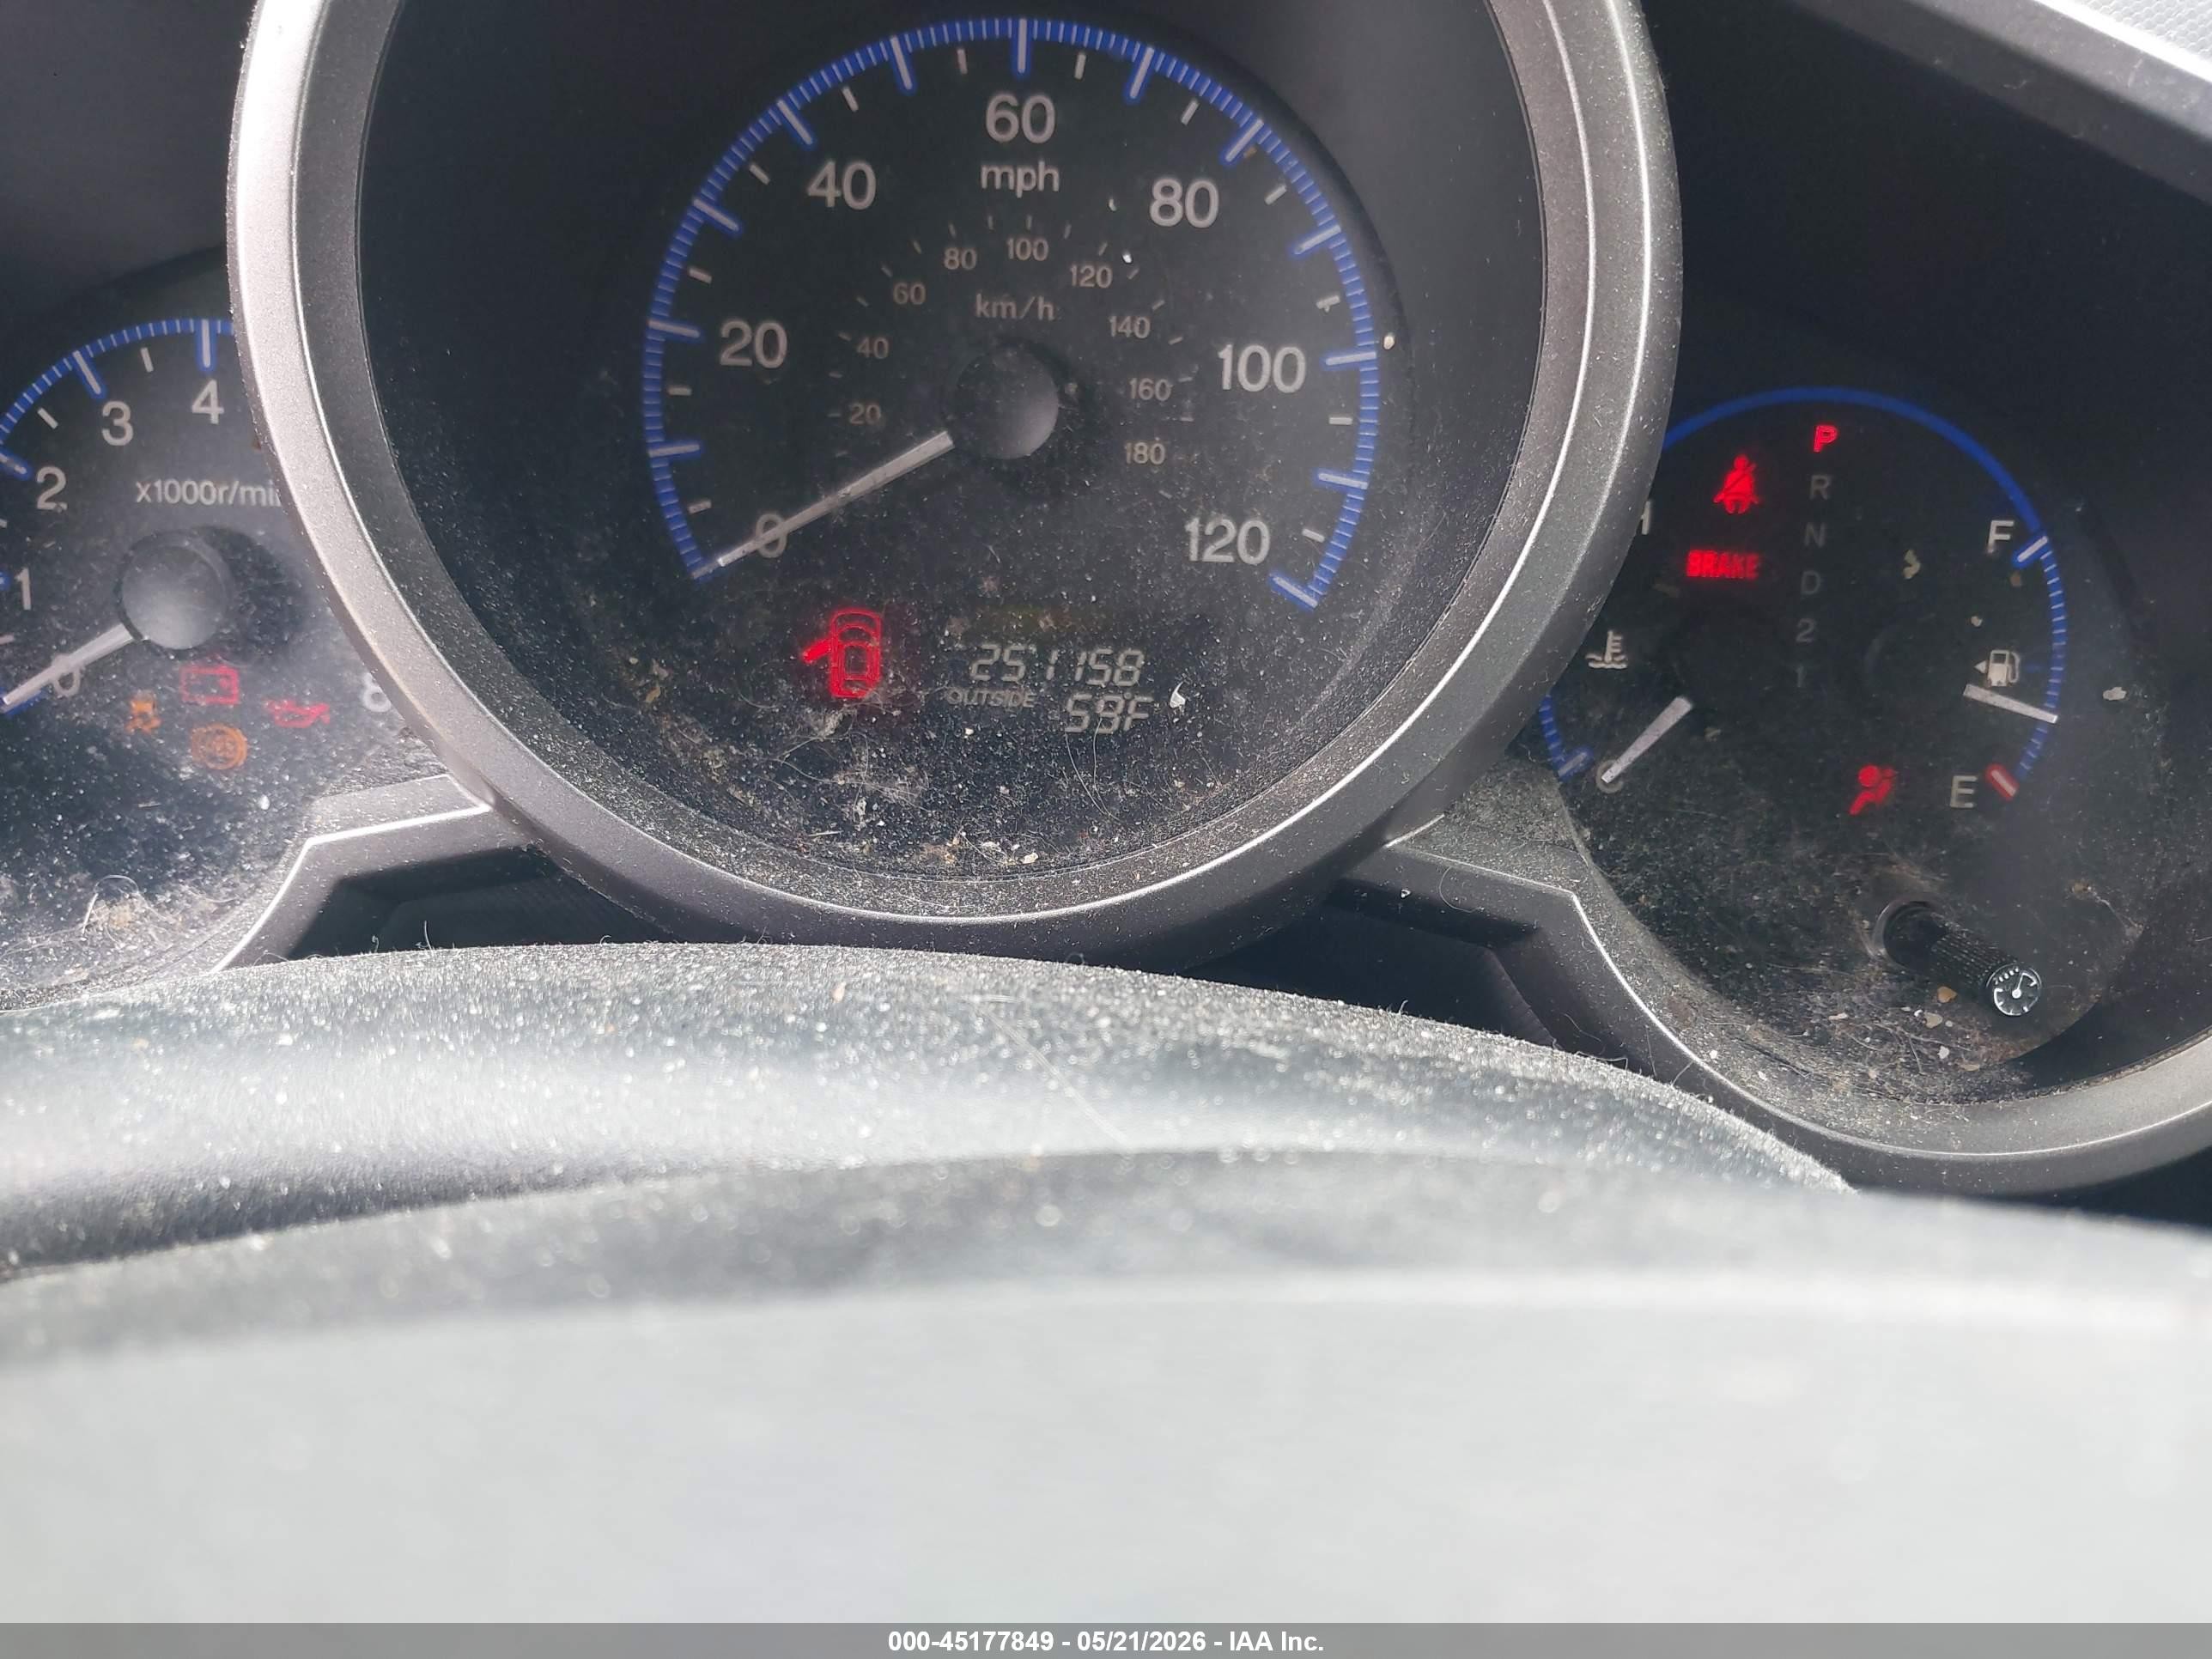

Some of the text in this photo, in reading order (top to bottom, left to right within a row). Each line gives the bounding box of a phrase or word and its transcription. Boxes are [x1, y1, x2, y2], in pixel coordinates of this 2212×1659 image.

[984, 93, 1057, 144] 60
[807, 161, 877, 210] 40
[980, 163, 1060, 198] mph
[1149, 178, 1219, 228] 80
[944, 247, 978, 271] 80
[1006, 237, 1049, 262] 100
[1070, 264, 1113, 289] 120
[893, 282, 927, 306] 60
[975, 294, 1055, 321] km/h
[1109, 315, 1151, 339] 140
[720, 321, 788, 368] 20
[857, 337, 890, 359] 40
[1217, 345, 1307, 393] 100
[191, 380, 224, 424] 4
[1128, 377, 1172, 402] 160
[102, 401, 133, 446] 3
[848, 402, 882, 426] 20
[1813, 424, 1838, 452] P
[1125, 442, 1166, 467] 180
[36, 466, 68, 511] 2
[1809, 473, 1831, 500] R
[755, 514, 787, 558] 0
[1184, 517, 1270, 564] 120
[1804, 522, 1826, 548] N
[1987, 520, 2014, 554] F
[1686, 550, 1759, 580] BRAKE
[15, 568, 31, 611] 1
[1801, 570, 1821, 596] D
[1796, 617, 1816, 643] 2
[970, 644, 1146, 687] 251158
[945, 688, 1036, 709] OUTSIDE
[1951, 776, 1977, 809] E
